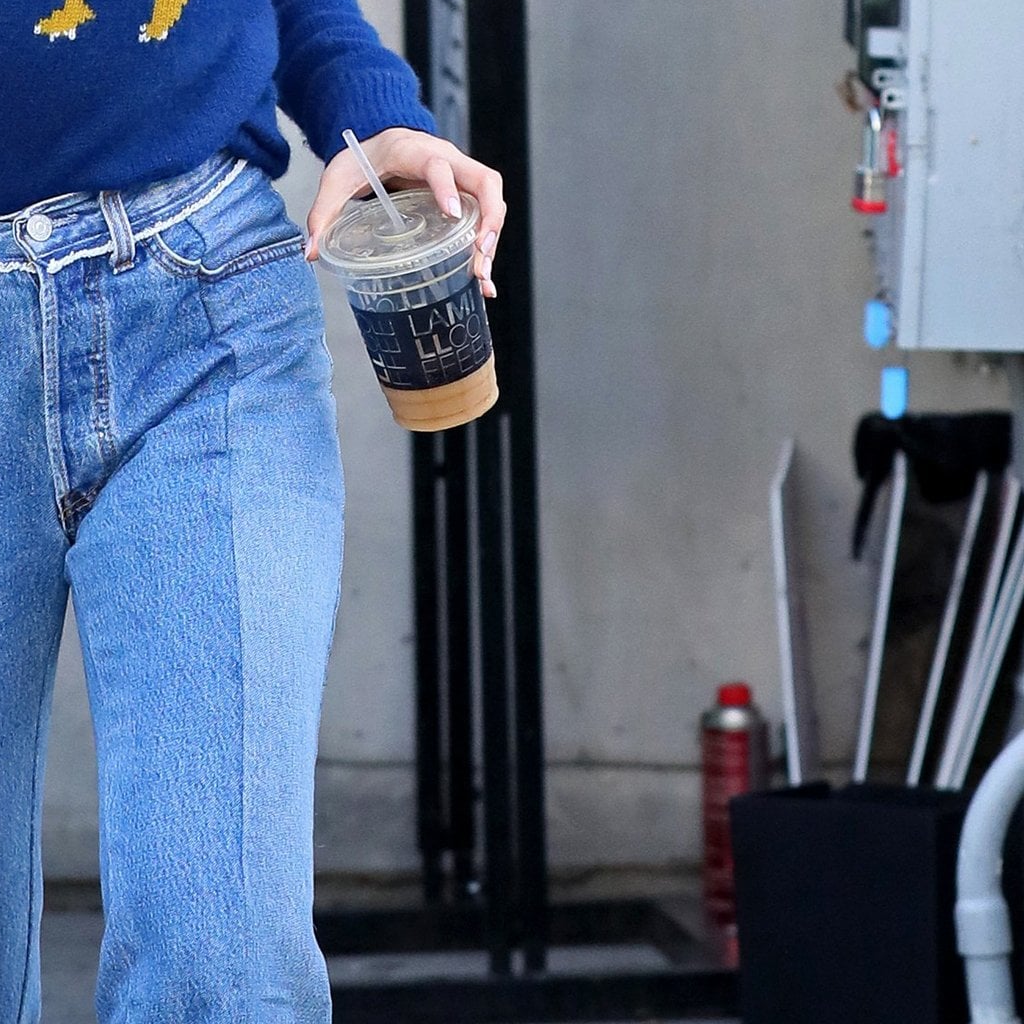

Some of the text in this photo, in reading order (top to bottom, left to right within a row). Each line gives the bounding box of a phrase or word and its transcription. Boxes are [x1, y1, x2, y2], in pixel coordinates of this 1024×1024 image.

[408, 288, 476, 337] LAMI
[415, 312, 481, 360] LLCO
[421, 334, 487, 384] FFEE
